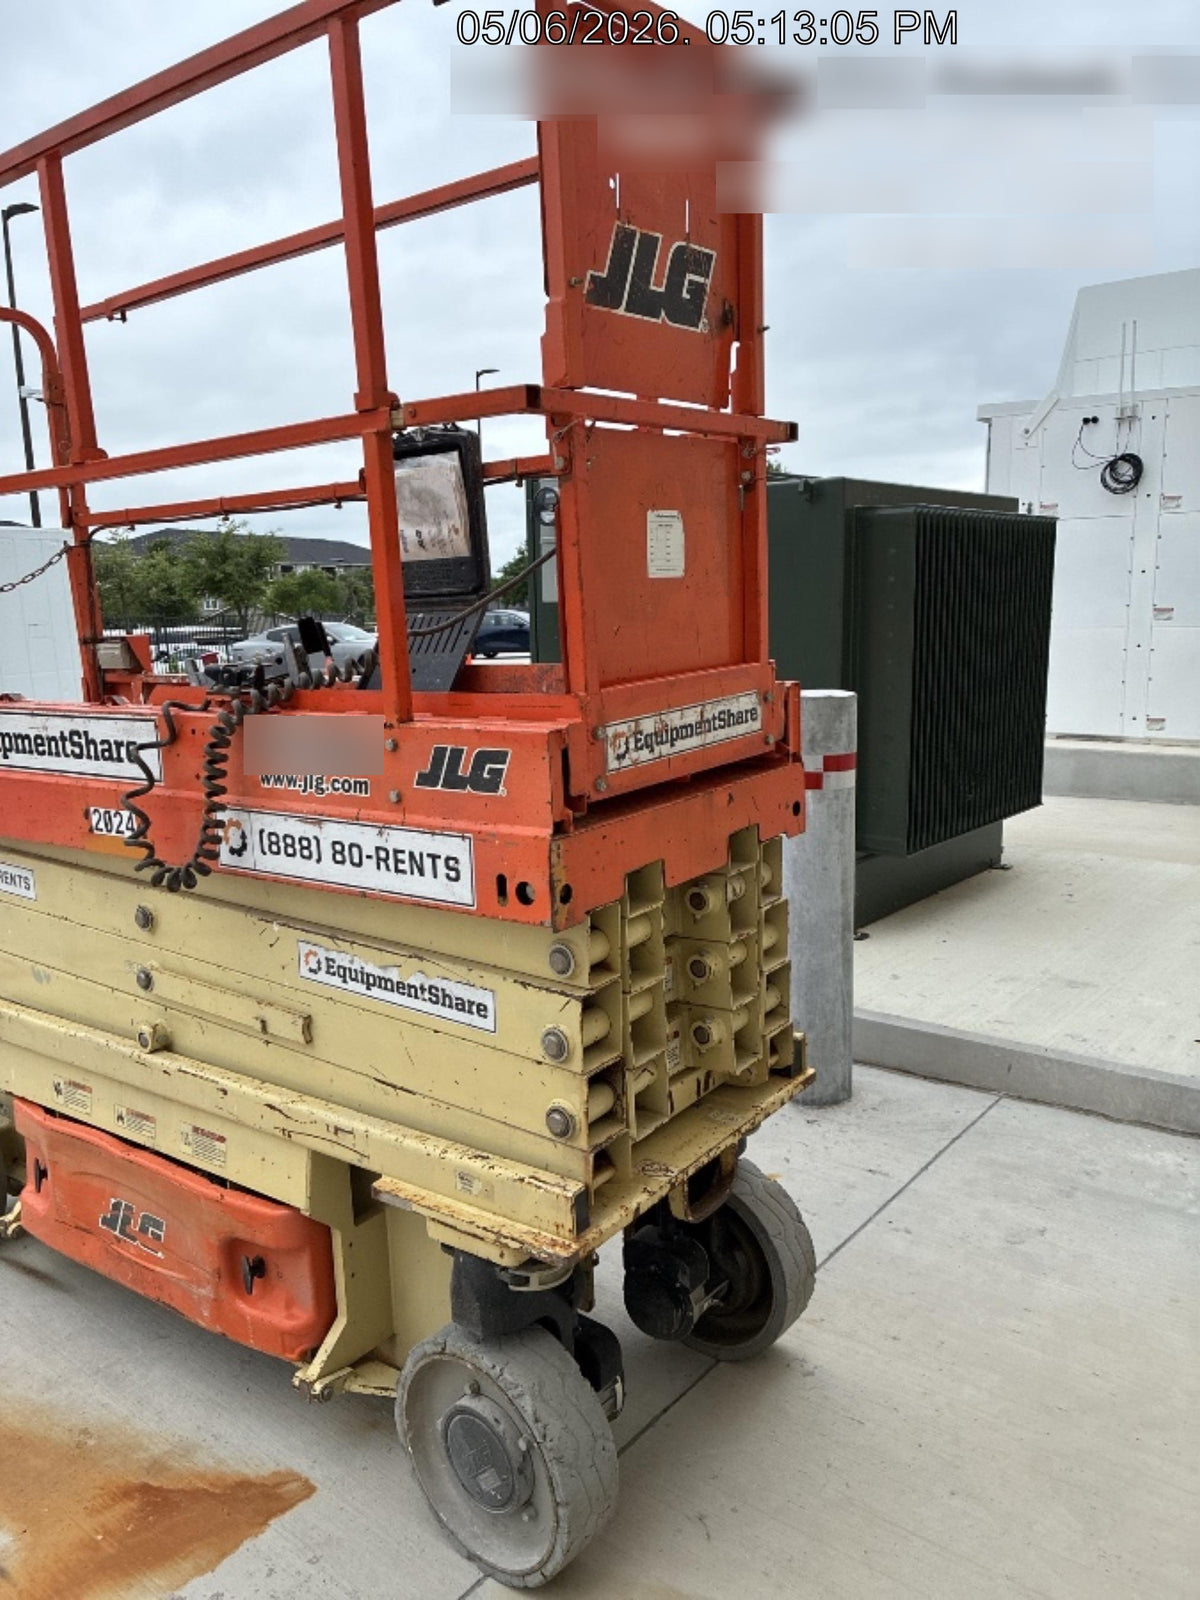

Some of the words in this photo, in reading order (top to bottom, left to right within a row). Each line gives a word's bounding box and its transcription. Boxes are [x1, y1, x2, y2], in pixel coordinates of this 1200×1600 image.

[583, 220, 717, 333] JLG
[633, 705, 759, 752] EquipmentShare
[413, 744, 512, 797] JLG
[92, 808, 136, 834] 2024
[258, 828, 322, 865] (888)
[331, 840, 461, 883] 80-RENTS
[324, 956, 489, 1019] EquipmentShare
[98, 1197, 166, 1259] JLG
